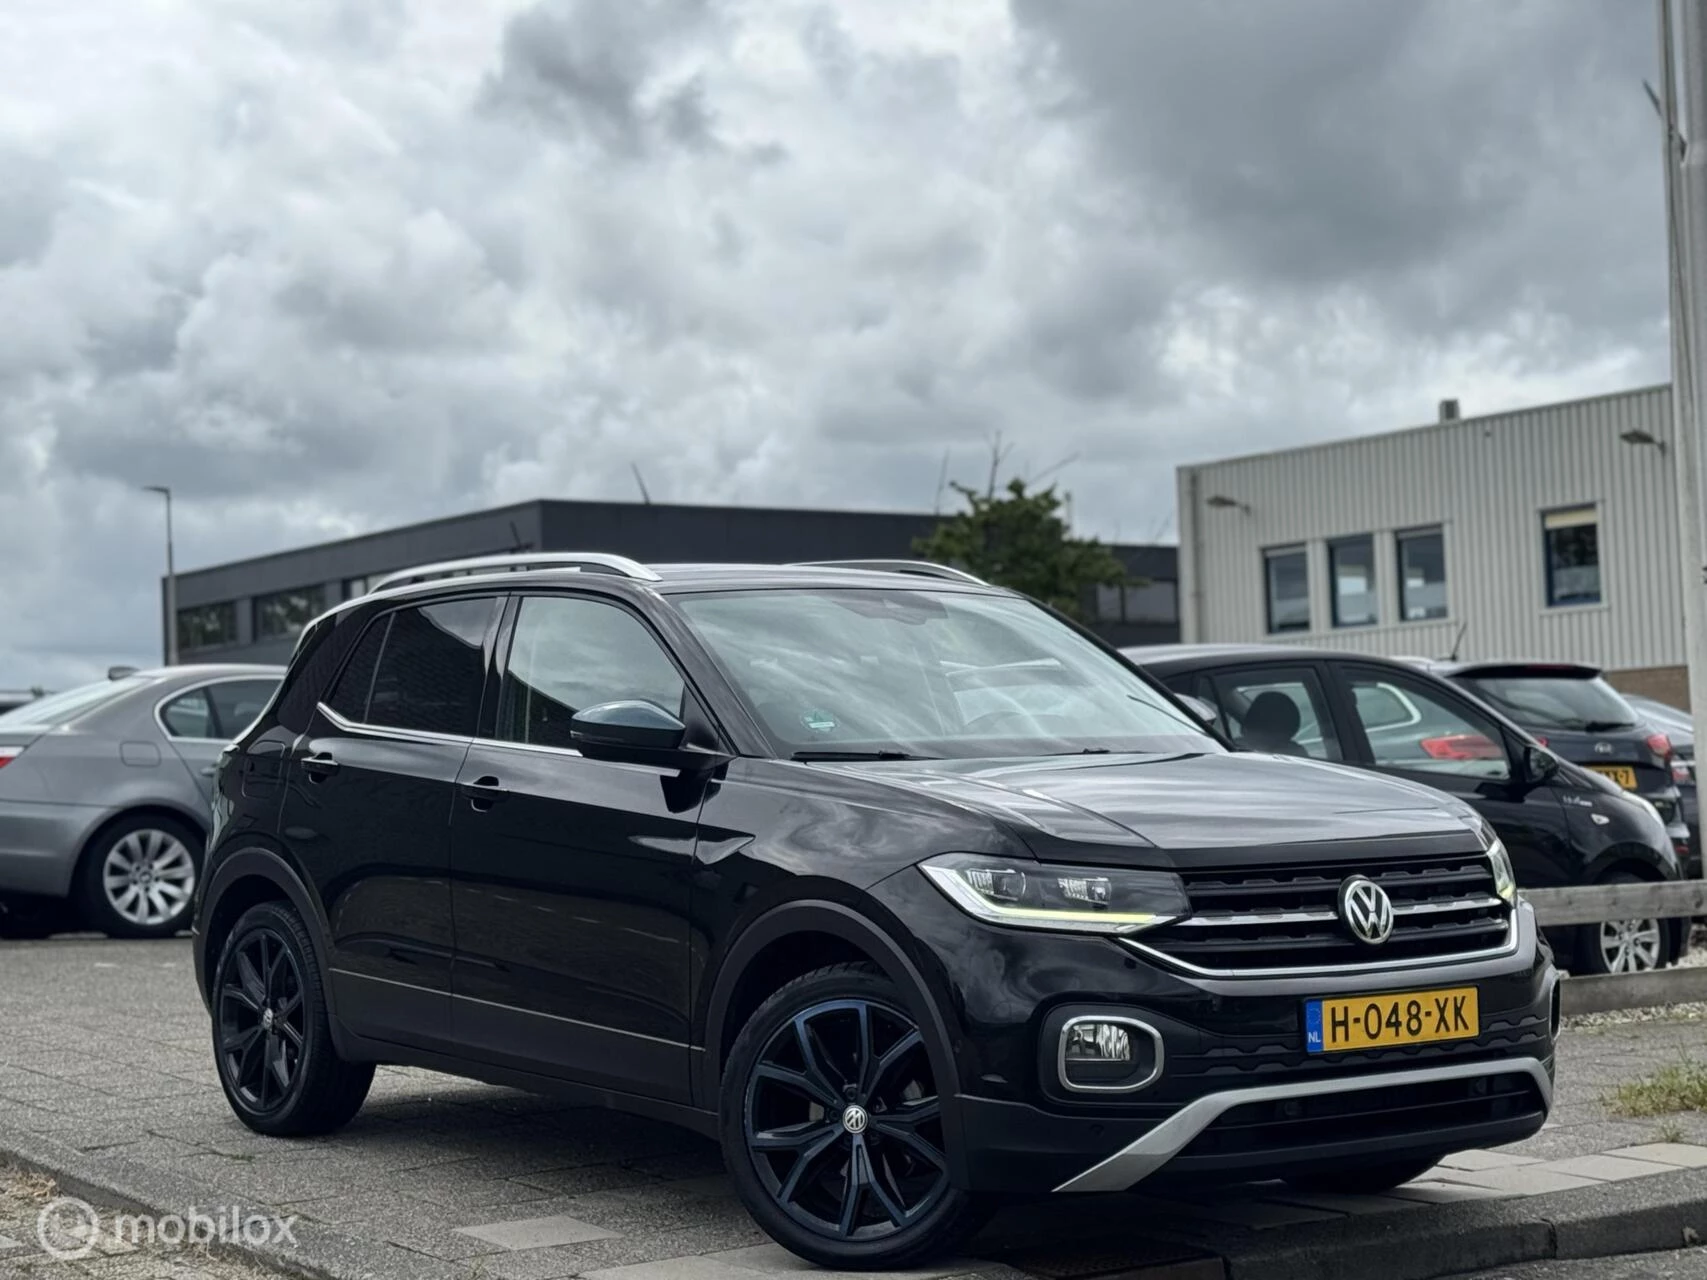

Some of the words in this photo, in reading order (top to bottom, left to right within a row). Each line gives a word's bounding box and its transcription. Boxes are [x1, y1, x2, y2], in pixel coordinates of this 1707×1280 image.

[1345, 880, 1393, 944] VW
[1308, 1031, 1321, 1043] NL
[1331, 995, 1469, 1043] H-048-XK
